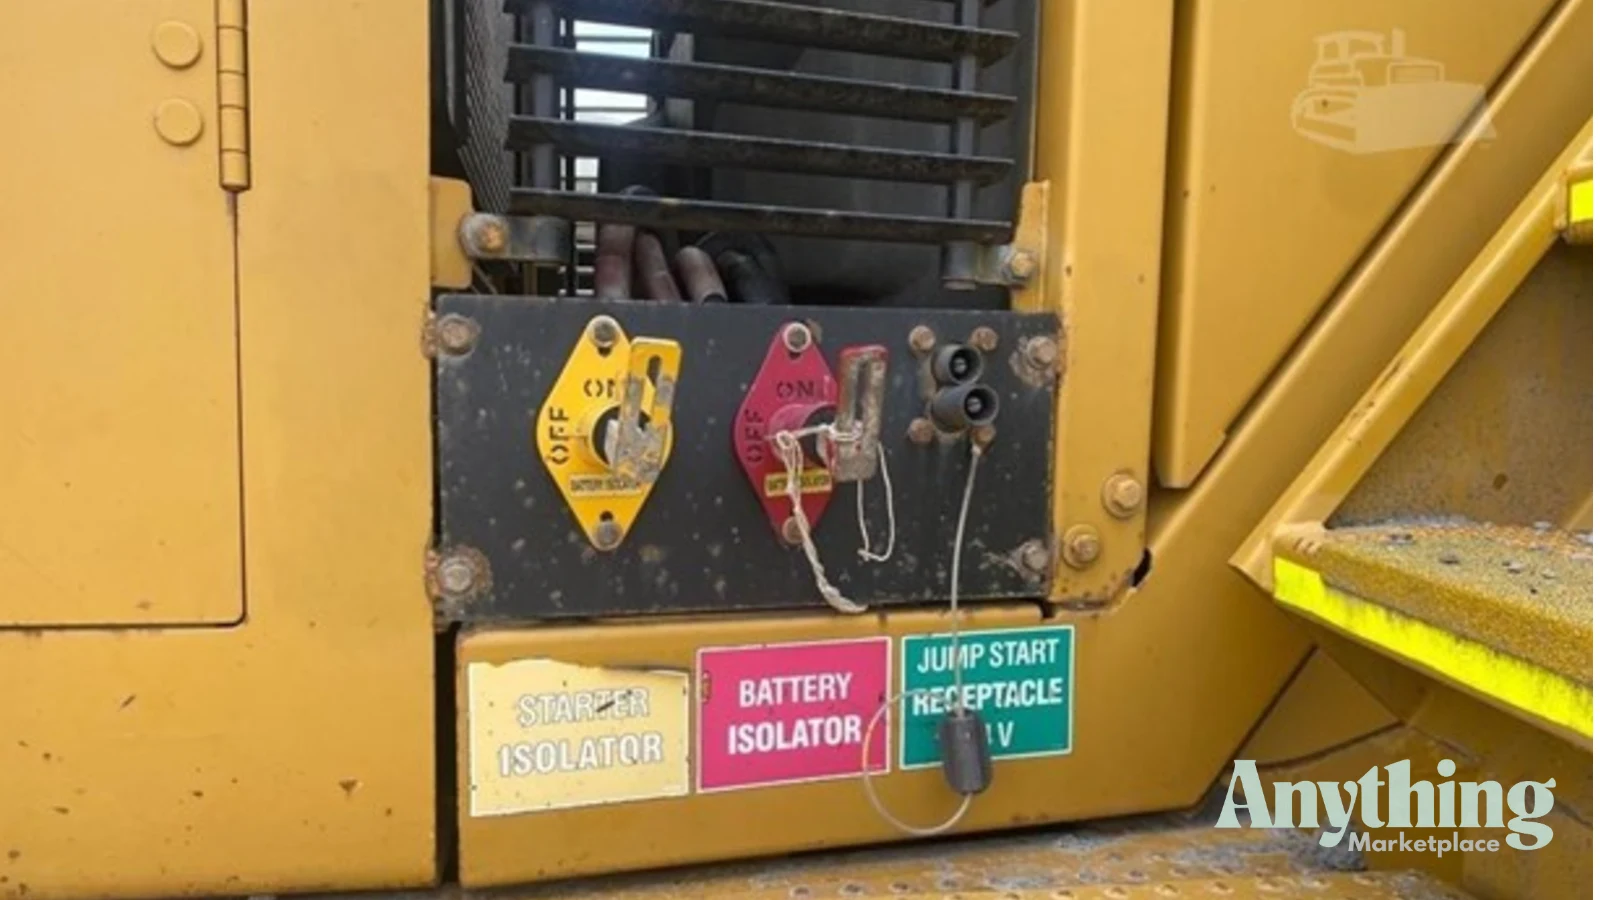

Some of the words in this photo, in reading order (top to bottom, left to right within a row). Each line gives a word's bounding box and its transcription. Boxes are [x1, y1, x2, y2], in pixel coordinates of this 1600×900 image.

[776, 380, 814, 398] ON
[548, 406, 569, 465] OFF
[744, 408, 764, 462] OFF
[916, 643, 985, 673] JUMP
[989, 638, 1060, 668] START
[516, 687, 650, 728] STARTER
[739, 672, 853, 708] BATTERY
[912, 677, 1064, 716] RECEPTACLE
[499, 732, 663, 777] ISOLATOR
[728, 714, 862, 755] ISOLATOR
[997, 721, 1014, 748] V
